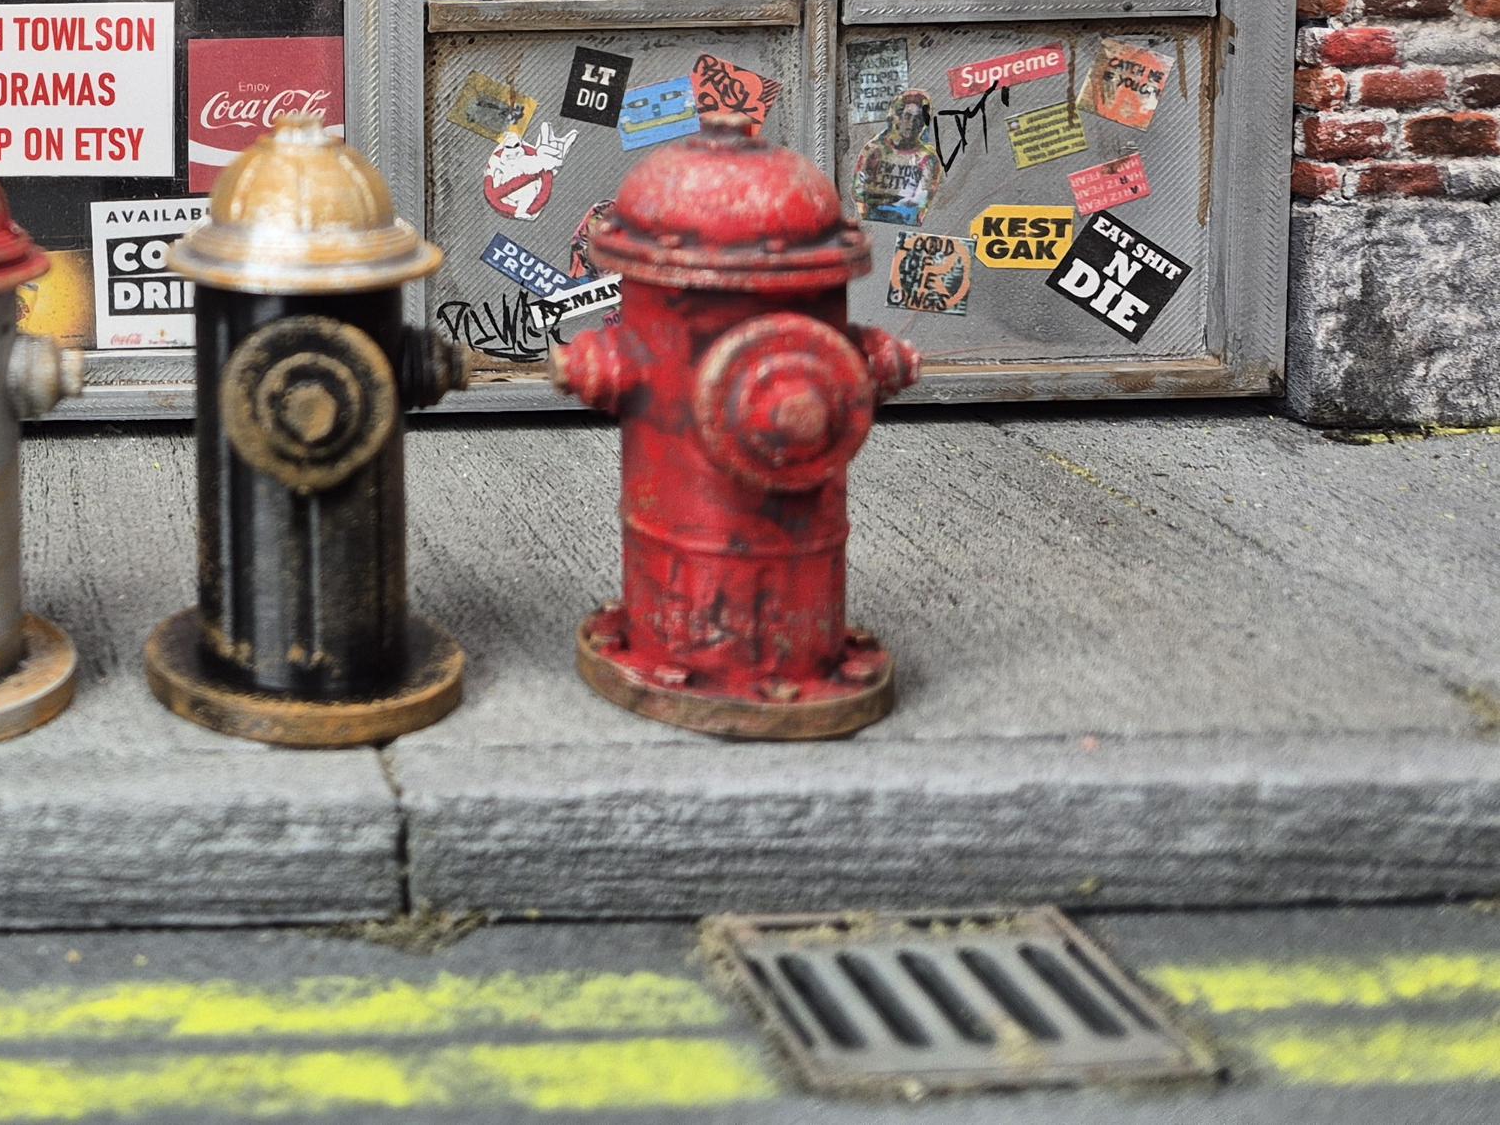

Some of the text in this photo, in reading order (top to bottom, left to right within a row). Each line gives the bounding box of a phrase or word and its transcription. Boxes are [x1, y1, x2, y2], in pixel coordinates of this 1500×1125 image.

[13, 17, 156, 52] TOWLSON
[238, 82, 270, 92] Enjoy
[580, 62, 617, 86] LT
[961, 52, 1060, 88] Supreme
[576, 88, 609, 111] DIO
[24, 128, 64, 161] ON
[75, 128, 144, 161] ETSY
[981, 216, 1073, 239] KEST
[502, 242, 568, 285] DUMP
[985, 239, 1059, 261] GAK
[1092, 216, 1182, 280] EAT SHIT
[1102, 250, 1143, 286] N
[1057, 257, 1150, 332] DIE
